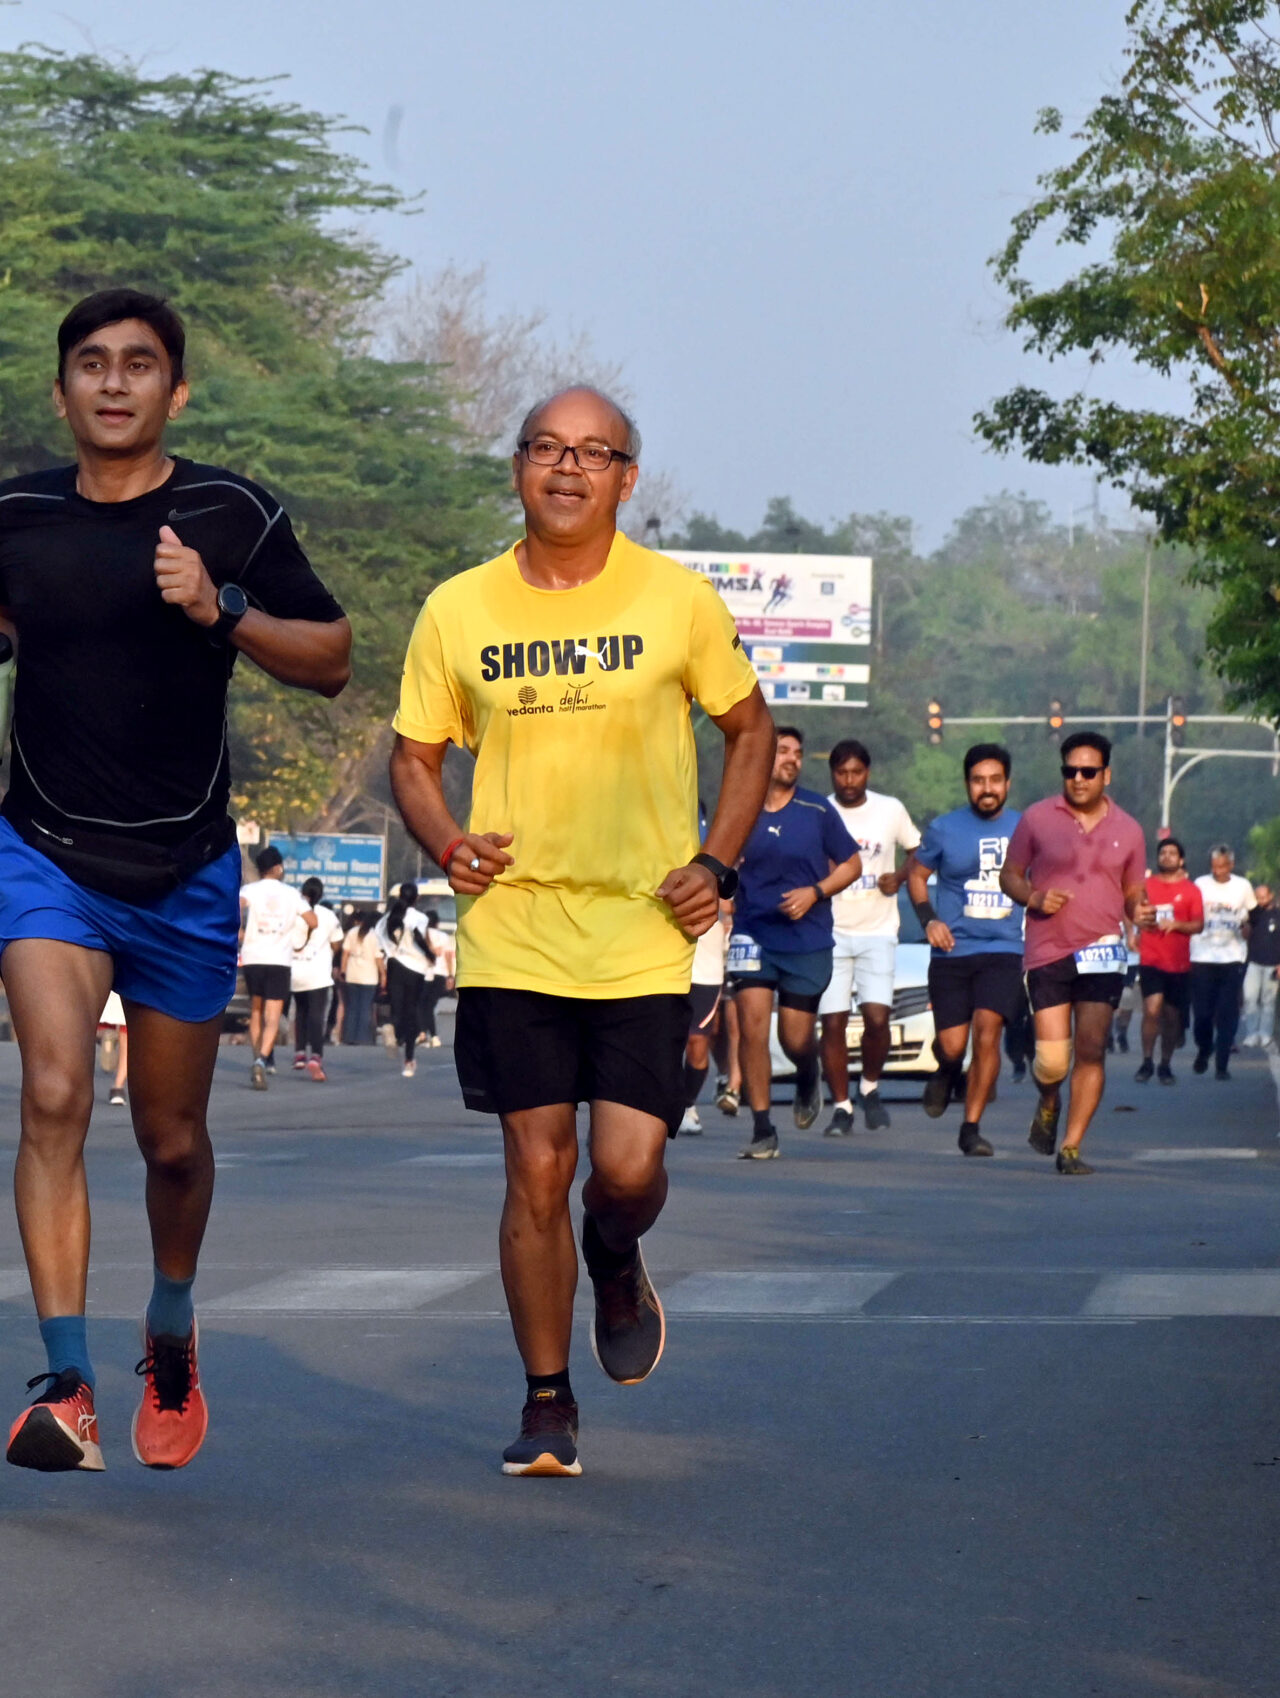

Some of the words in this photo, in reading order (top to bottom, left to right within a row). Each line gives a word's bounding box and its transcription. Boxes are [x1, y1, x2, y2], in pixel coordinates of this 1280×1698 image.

[480, 638, 588, 682] SHOW
[597, 634, 643, 672] UP
[506, 703, 555, 718] vedanta
[575, 704, 607, 713] marathon
[1078, 947, 1114, 962] 10213
